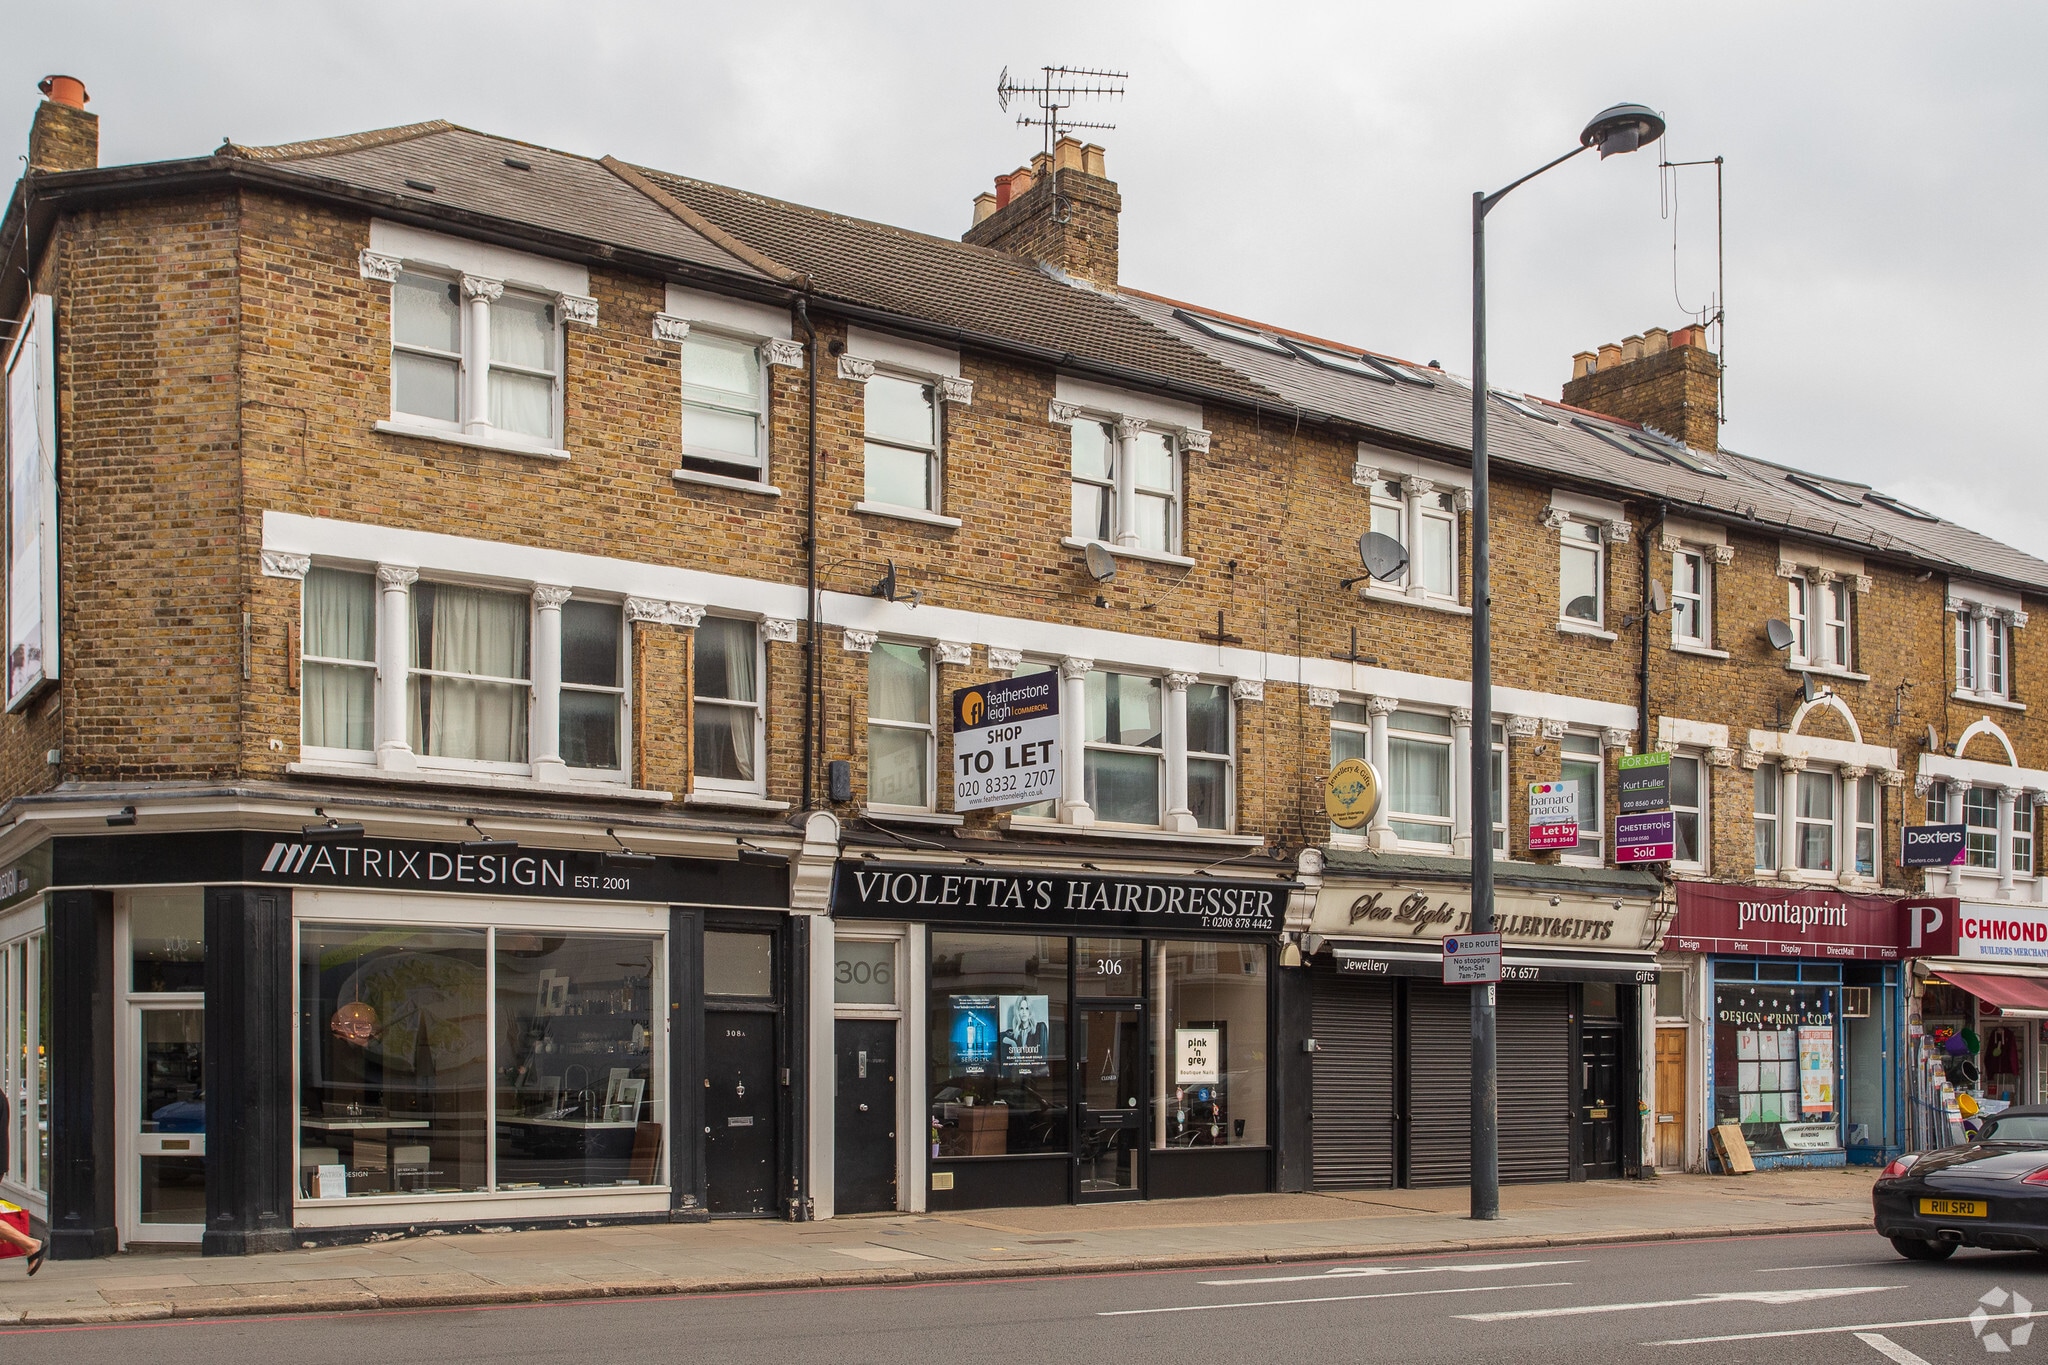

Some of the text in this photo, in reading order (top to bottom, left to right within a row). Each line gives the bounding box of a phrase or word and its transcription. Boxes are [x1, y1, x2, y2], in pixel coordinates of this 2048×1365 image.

[987, 684, 1049, 705] featherstone
[987, 703, 1049, 722] leigh COMMERCIAL
[987, 726, 1022, 744] SHOP
[959, 739, 1054, 776] TO LET
[1621, 753, 1666, 768] FOR SALE
[958, 769, 1056, 798] 020 8332 2707
[1328, 765, 1371, 789] Jewellery & Gifts
[1623, 779, 1665, 790] Kurt Fuller
[968, 788, 1044, 805] www.featherstoneleigh.co.uk
[1530, 793, 1574, 806] barnard
[1650, 798, 1664, 806] 4768
[1530, 805, 1569, 815] marcus
[1542, 825, 1576, 836] Let by
[1619, 821, 1671, 832] CHESTERTONS
[1908, 831, 1962, 845] Dexters
[1633, 846, 1656, 857] Sold
[429, 852, 565, 887] DESIGN
[574, 875, 599, 889] EST.
[602, 876, 631, 891] 2001
[853, 871, 1274, 919] VIOLETTA'S HAIRDRESSER
[1212, 917, 1233, 928] 0208
[1235, 918, 1250, 928] 878
[1252, 918, 1272, 930] 4442
[1350, 892, 1614, 941] Sea Light JELLERY&GIFTS
[1738, 899, 1848, 933] prontaprint
[1906, 906, 1944, 949] P
[1960, 918, 2048, 943] ICHMOND
[1475, 940, 1499, 948] ROUTE
[1679, 939, 1897, 958] Design Print Display DirectMail Finish
[1980, 945, 2013, 956] BUILDERS
[1096, 959, 1122, 975] 306
[1344, 959, 1388, 974] Jewellery
[1458, 964, 1485, 972] Mon-Sat
[1464, 957, 1491, 965] stopping
[834, 960, 891, 985] 306
[1502, 967, 1540, 979] 876 6577
[1635, 970, 1655, 982] Gifts
[1722, 1010, 1833, 1025] DESIGN PRINT COPY
[1188, 1038, 1207, 1049] pink
[1187, 1057, 1207, 1066] grey
[1951, 1202, 1975, 1214] SRD
